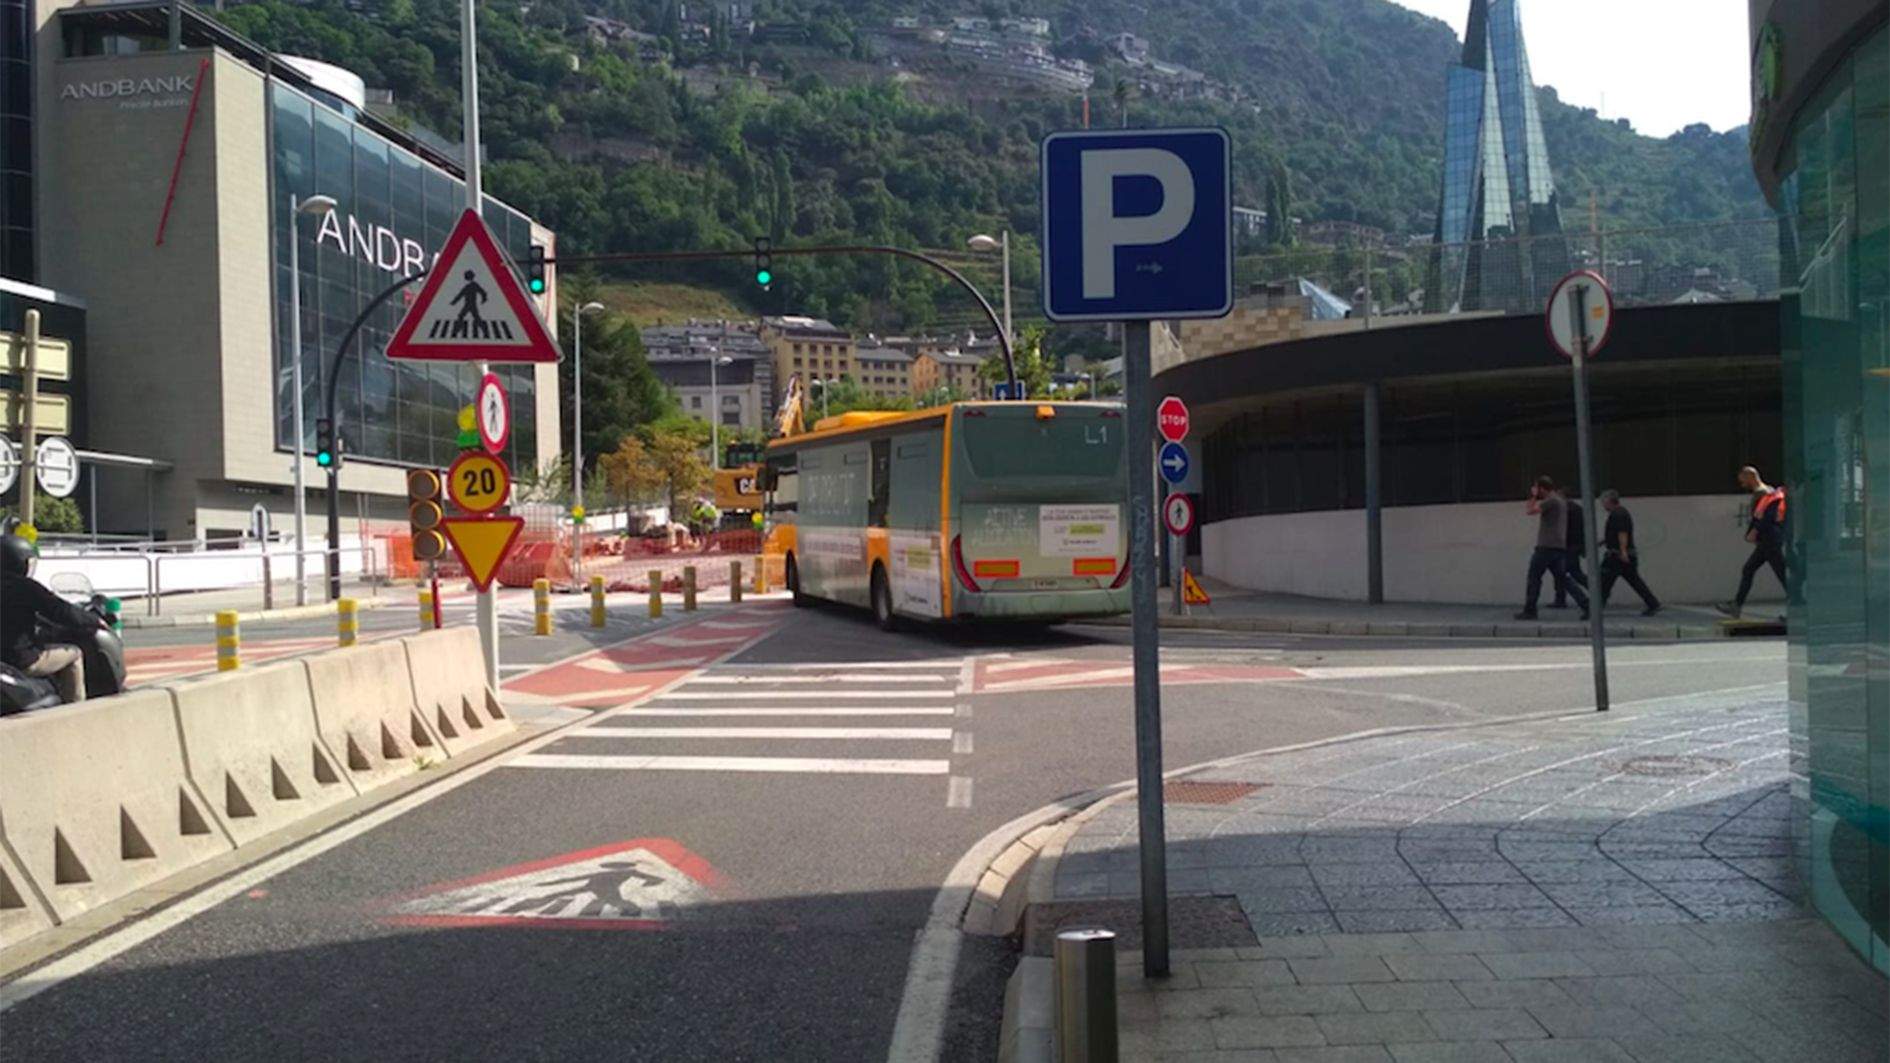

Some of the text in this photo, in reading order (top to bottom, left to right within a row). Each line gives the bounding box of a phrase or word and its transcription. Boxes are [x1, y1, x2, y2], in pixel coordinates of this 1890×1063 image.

[61, 75, 194, 98] ANDBANK
[1081, 148, 1195, 299] P
[317, 208, 440, 281] ANDB
[1162, 414, 1187, 426] STOP
[1084, 425, 1107, 444] L1
[463, 467, 496, 496] 20
